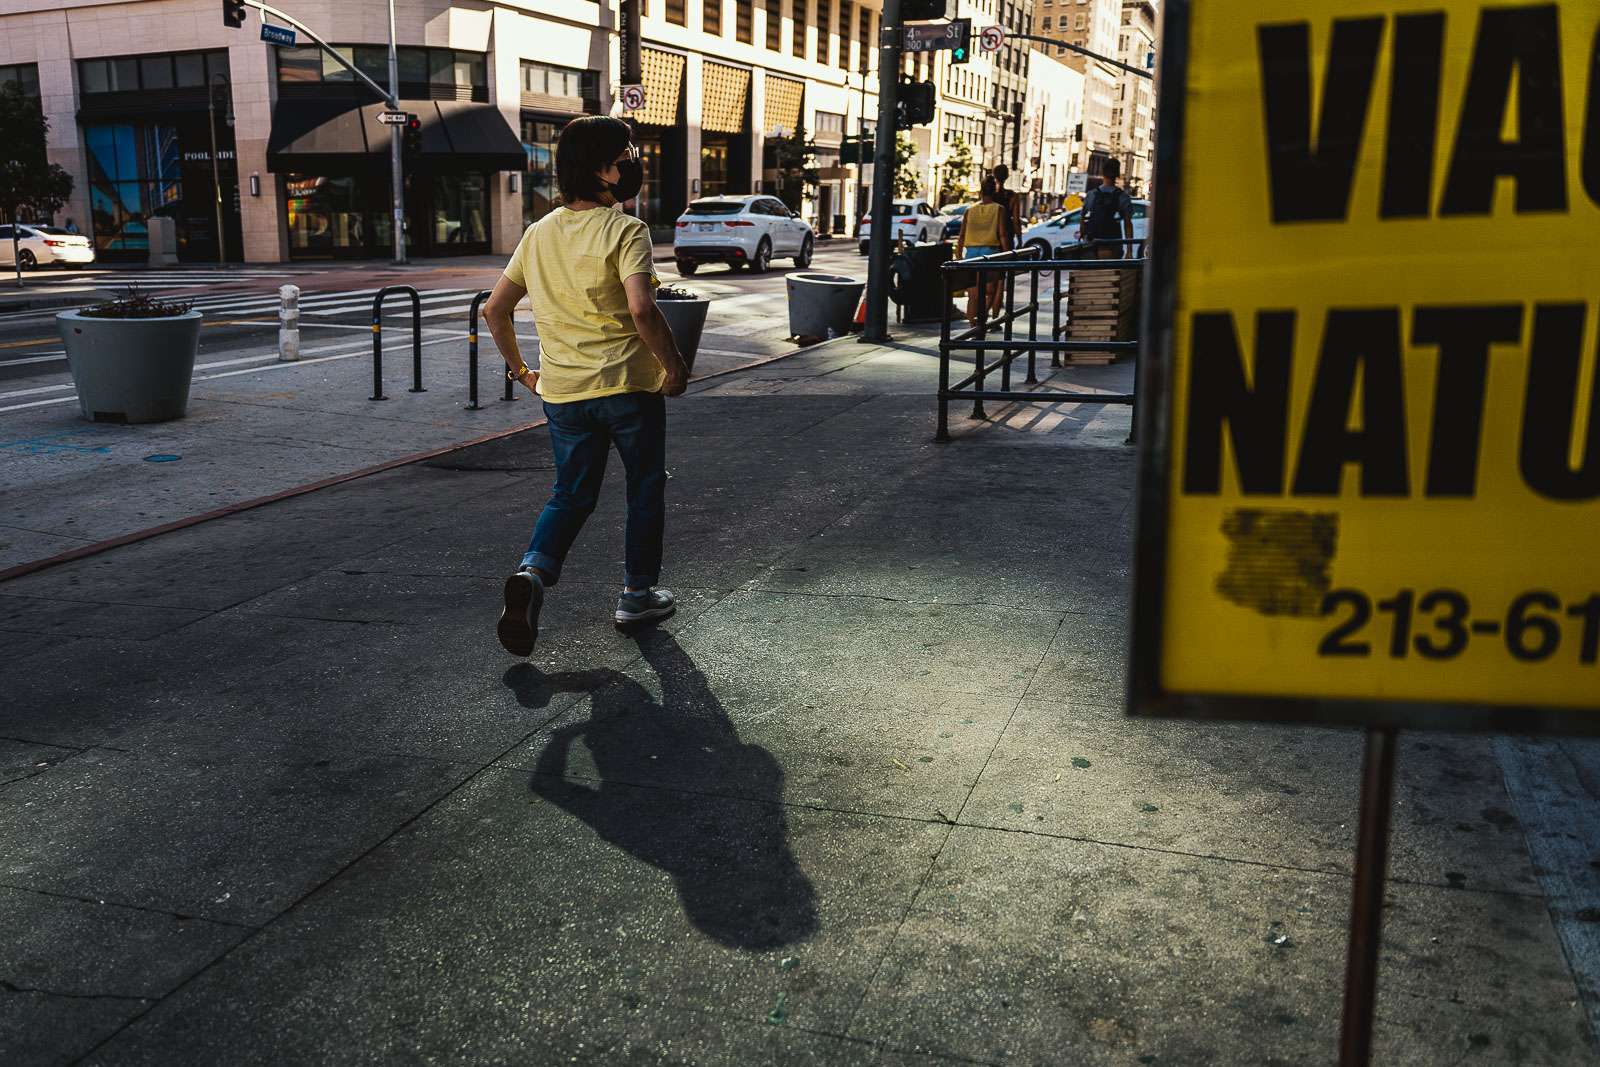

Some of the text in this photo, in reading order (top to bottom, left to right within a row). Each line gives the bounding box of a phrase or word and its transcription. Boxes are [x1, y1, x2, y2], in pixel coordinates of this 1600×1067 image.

[946, 24, 959, 39] St
[1257, 3, 1600, 226] VIA
[1317, 587, 1600, 666] 213-61
